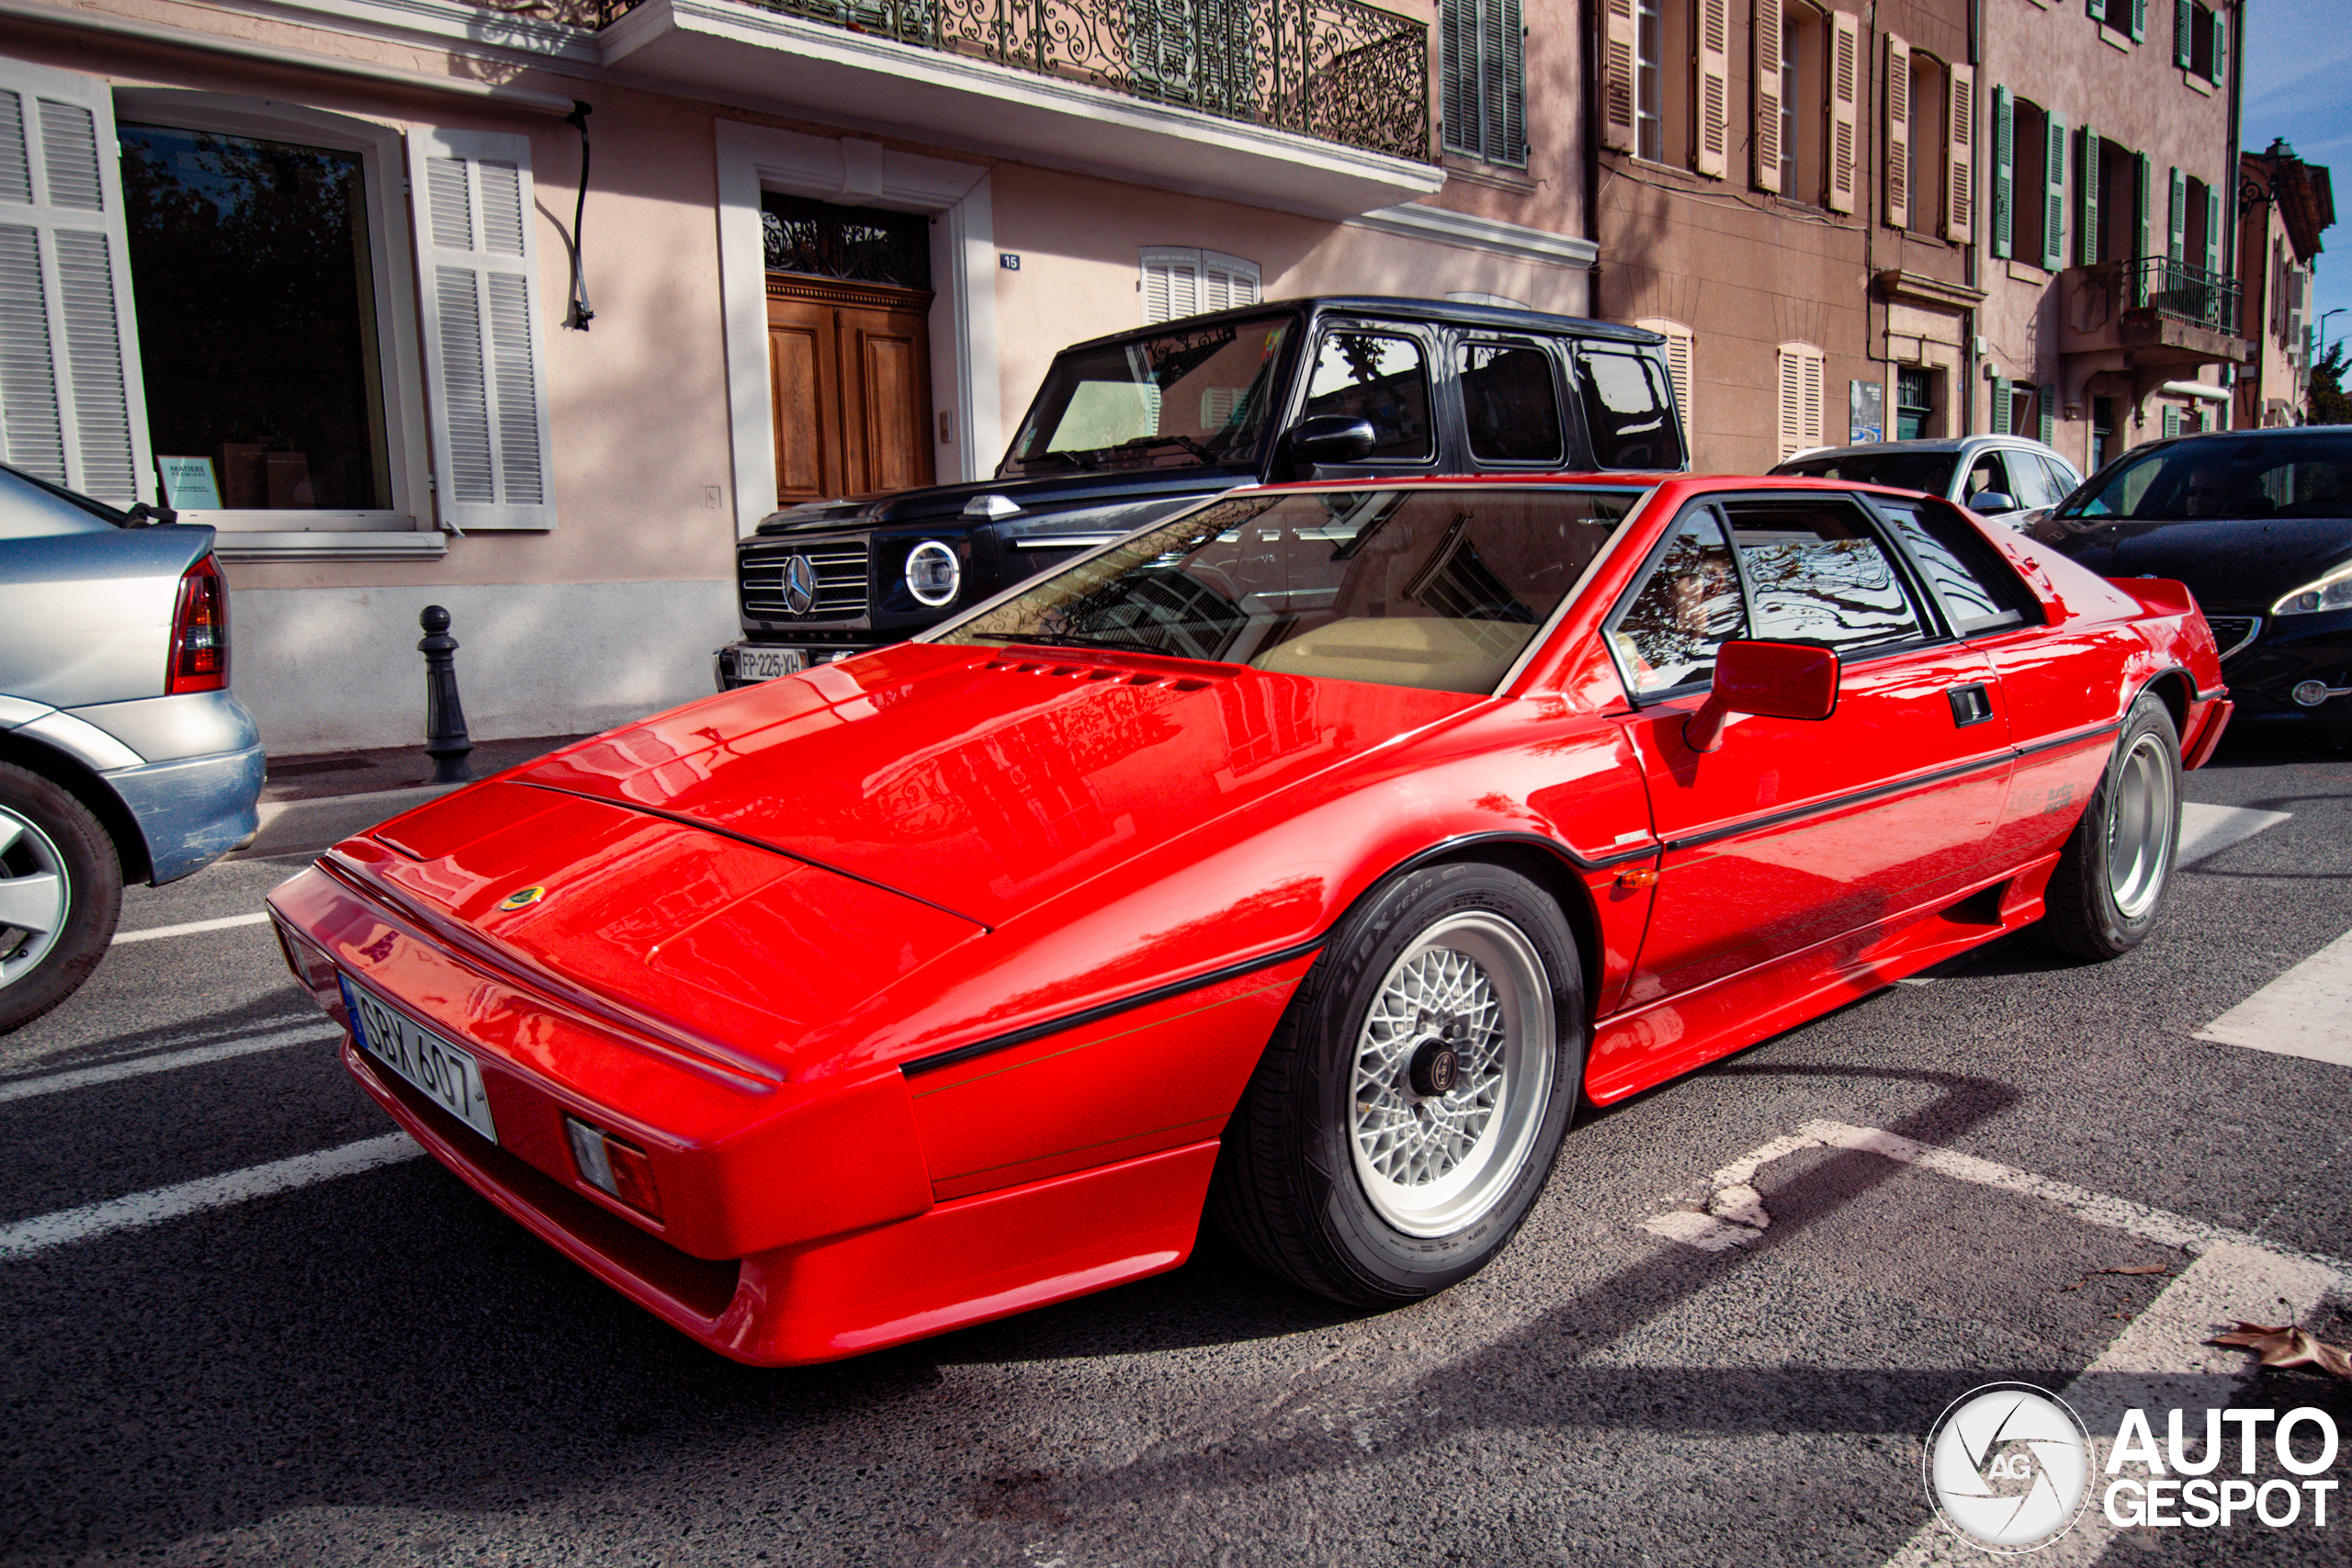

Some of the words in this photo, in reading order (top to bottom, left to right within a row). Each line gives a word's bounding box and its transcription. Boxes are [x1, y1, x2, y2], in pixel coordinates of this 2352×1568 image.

[1004, 255, 1017, 268] 15
[742, 653, 799, 677] FP-225-XH
[361, 994, 417, 1079] SBX
[418, 1032, 470, 1118] 607
